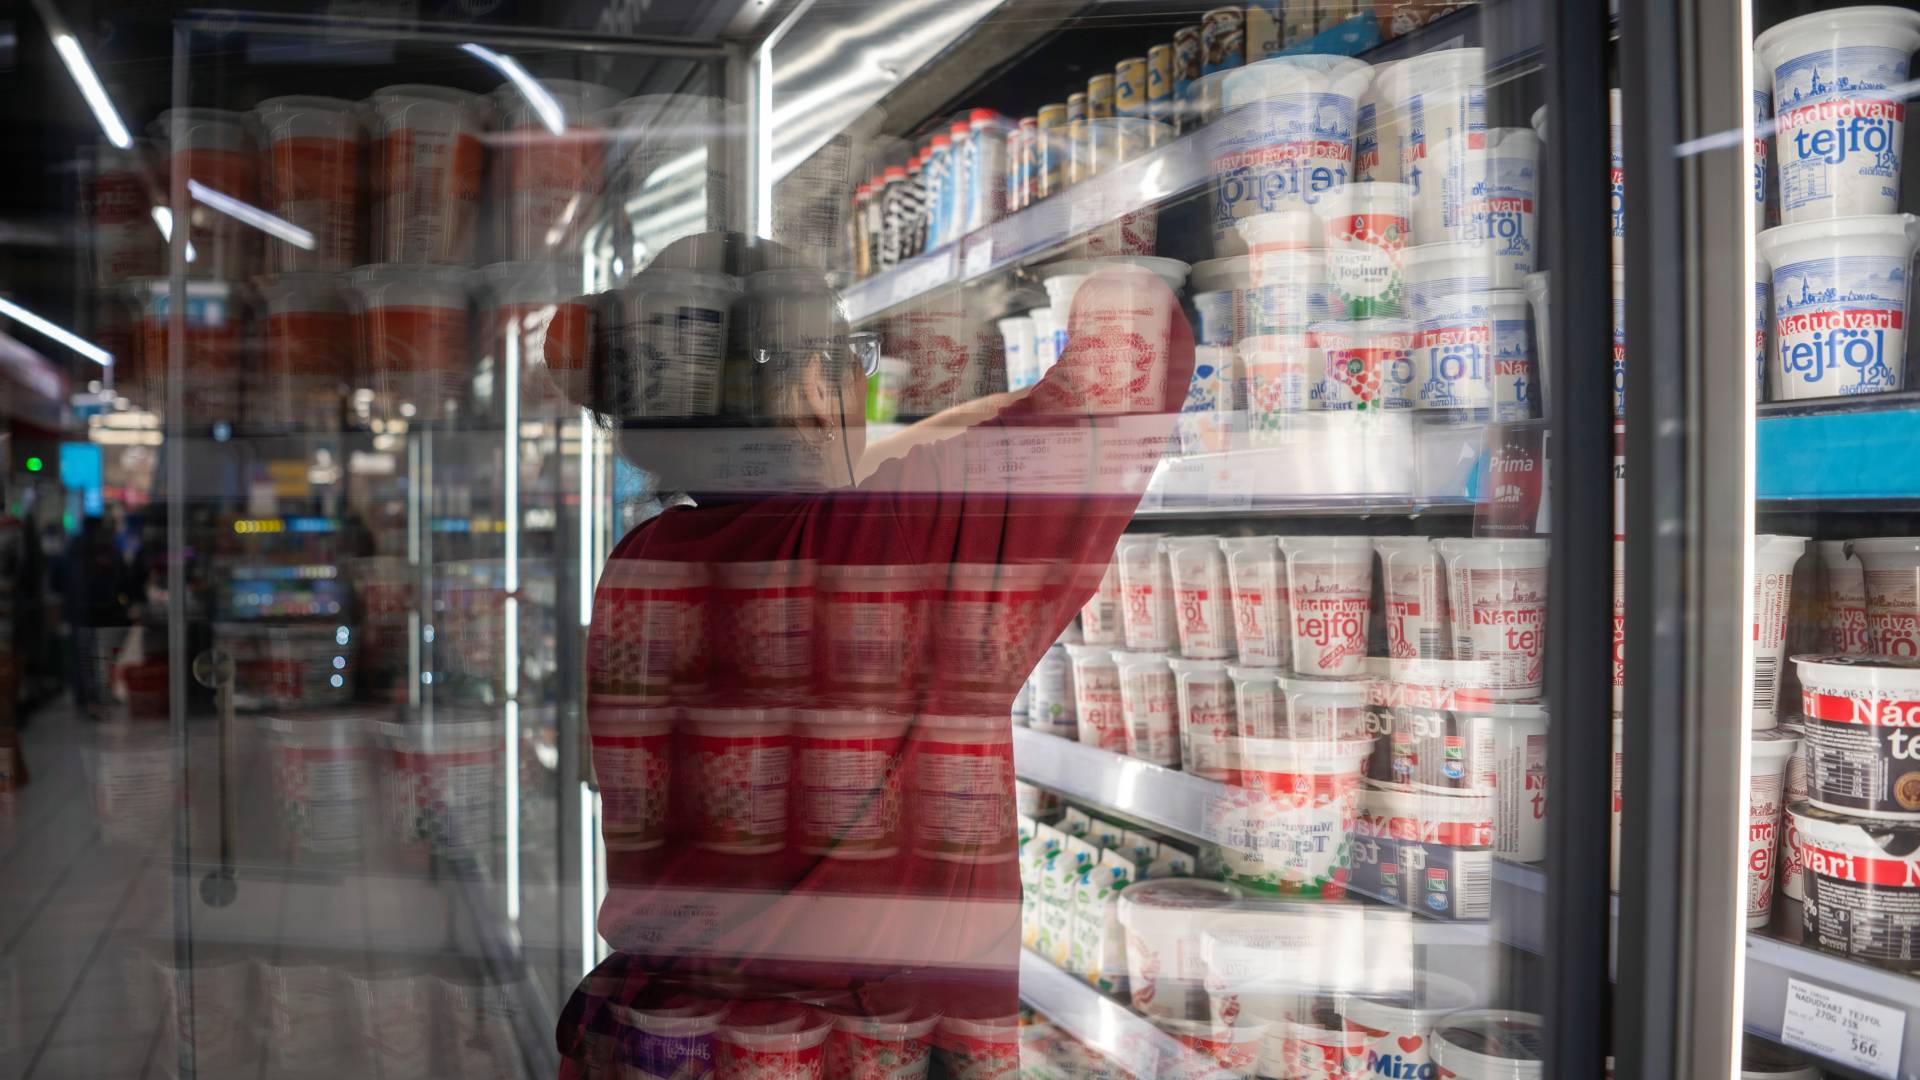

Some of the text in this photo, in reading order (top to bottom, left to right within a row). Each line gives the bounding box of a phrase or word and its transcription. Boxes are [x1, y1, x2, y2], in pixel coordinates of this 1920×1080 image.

[1778, 100, 1898, 134] Nádudvari
[1794, 117, 1895, 164] tejföl
[1340, 266, 1389, 280] Joghurt
[1778, 310, 1893, 337] Nádudvari
[1782, 328, 1886, 383] tejföl
[1857, 367, 1896, 387] 12%
[1489, 456, 1534, 473] Prima
[1297, 612, 1364, 646] tejföl
[1802, 847, 1857, 881] vari
[1795, 992, 1843, 1015] NADUDVARI
[1851, 1038, 1878, 1058] 566
[1367, 1050, 1437, 1080] Mizo
